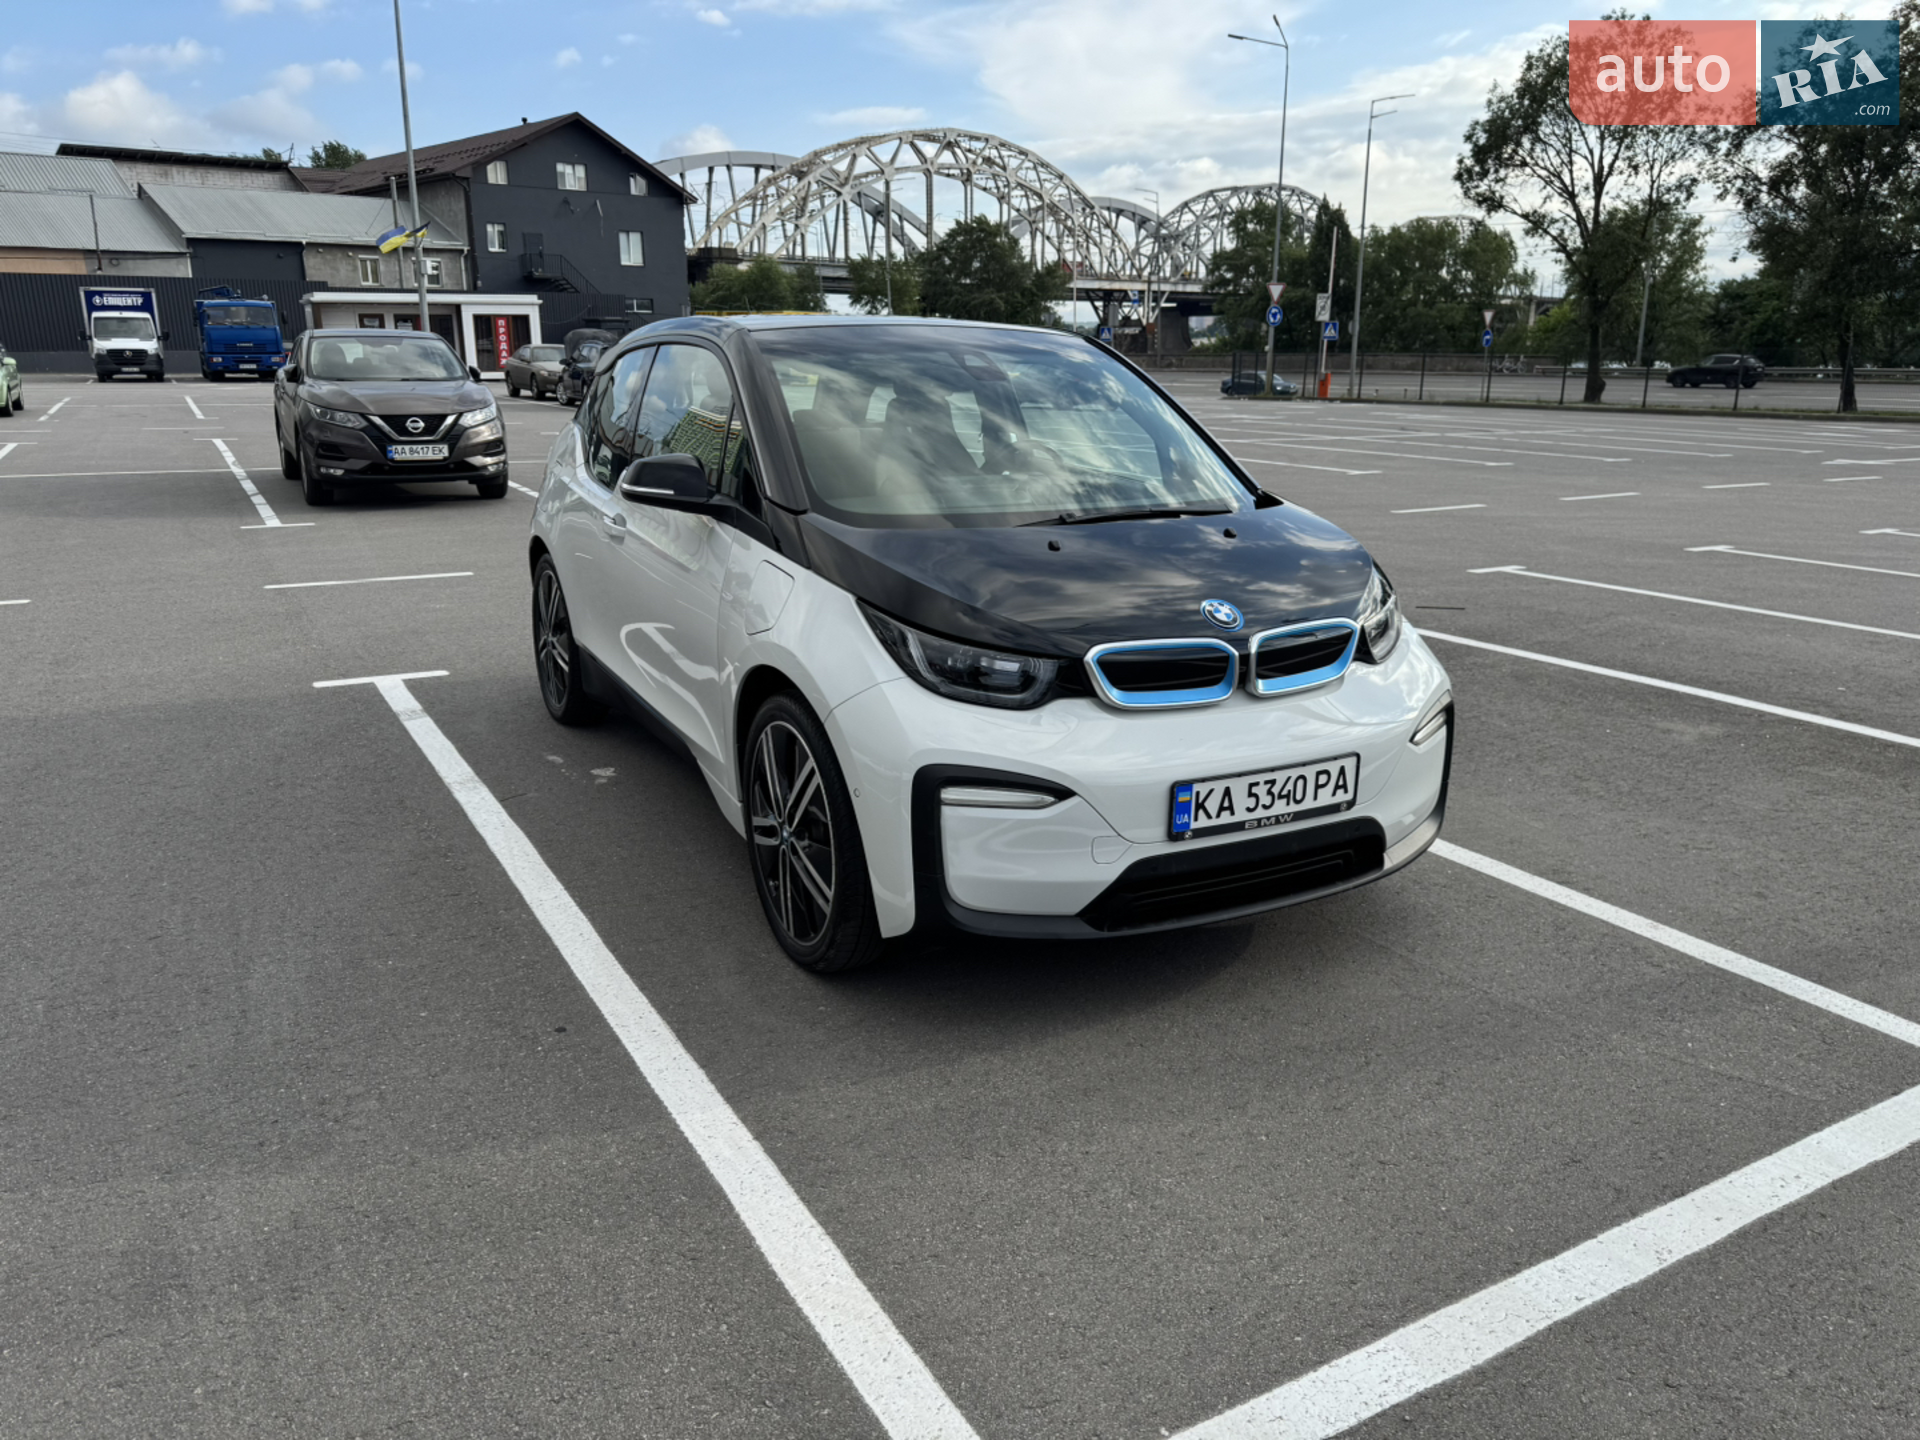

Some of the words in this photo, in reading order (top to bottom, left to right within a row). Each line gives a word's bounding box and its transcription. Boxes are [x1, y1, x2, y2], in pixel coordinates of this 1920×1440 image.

[394, 446, 407, 456] AA
[408, 446, 430, 456] 8417
[431, 446, 446, 456] EK
[1193, 786, 1236, 822] KA
[1245, 774, 1308, 813] 5340
[1313, 765, 1349, 801] PA
[1175, 813, 1189, 825] UA
[1244, 813, 1294, 829] BMW
